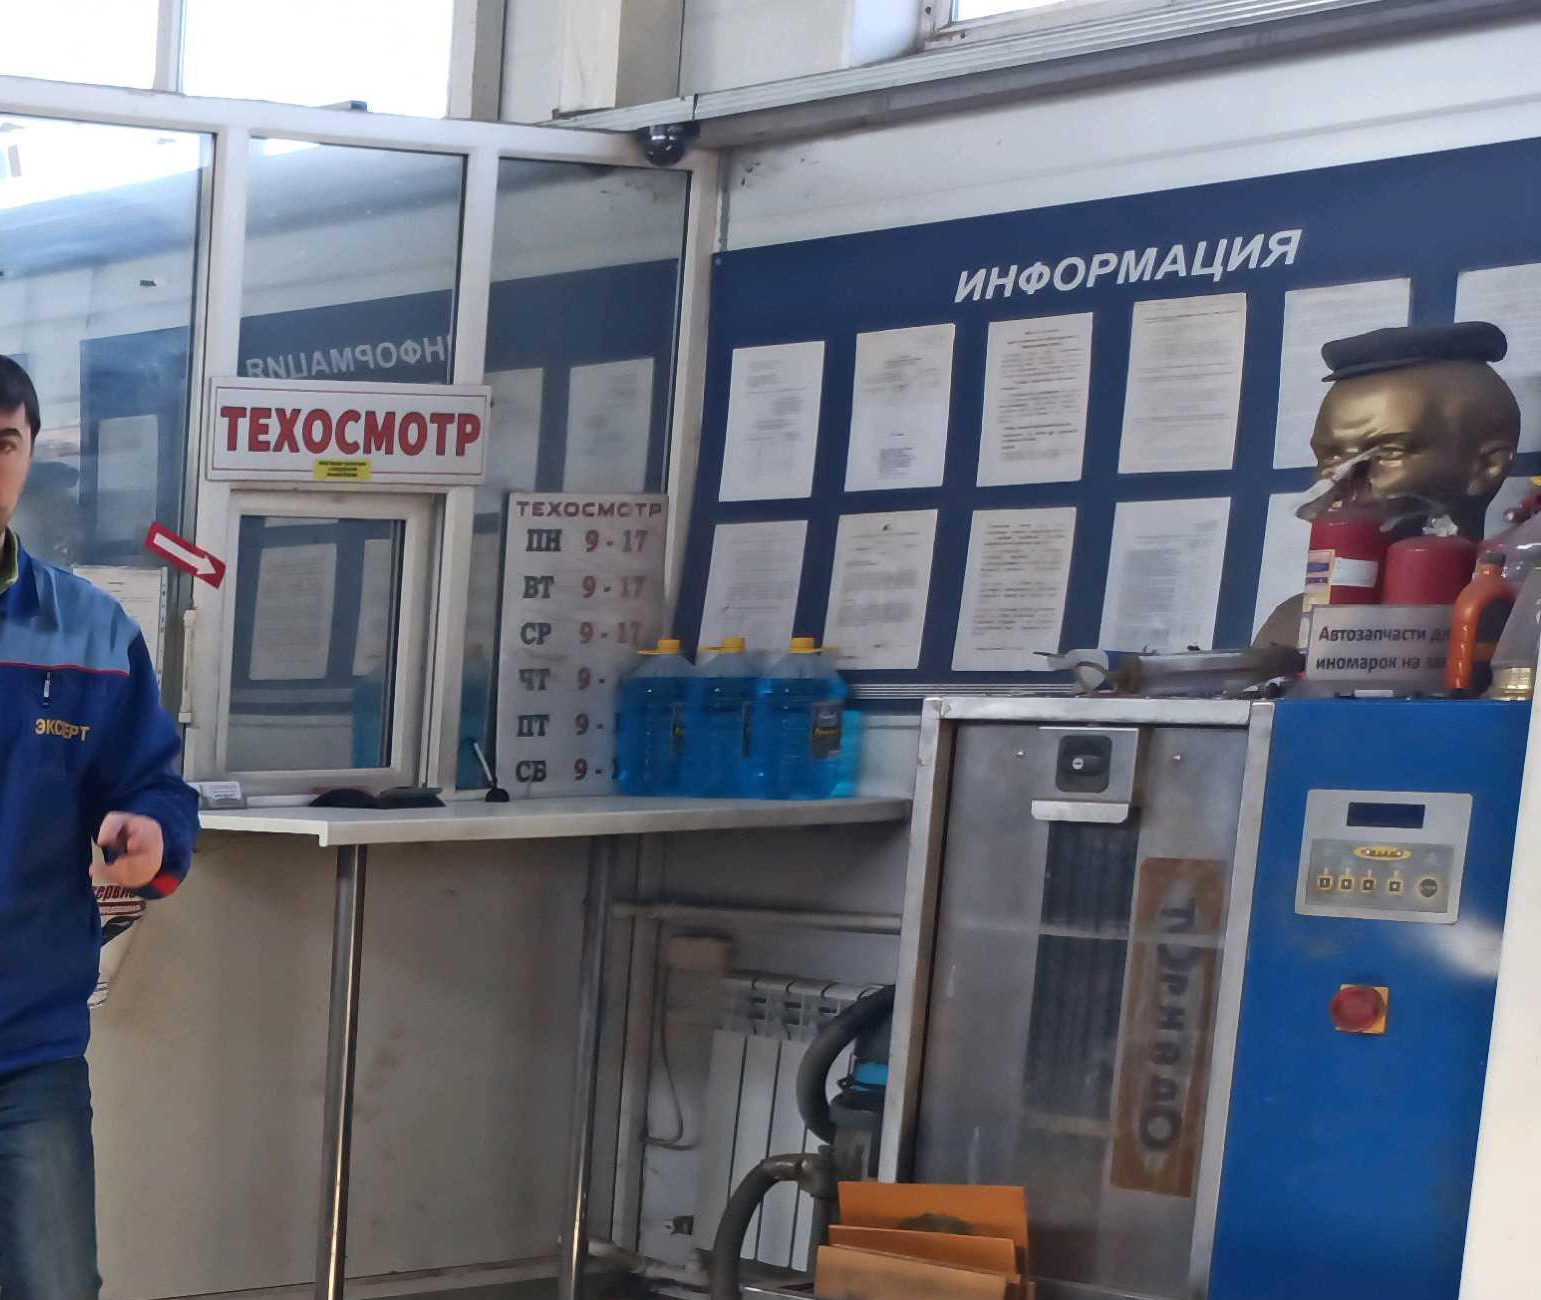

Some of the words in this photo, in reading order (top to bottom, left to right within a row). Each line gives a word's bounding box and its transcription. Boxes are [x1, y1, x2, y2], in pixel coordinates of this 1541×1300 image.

[953, 228, 1303, 303] ИНФОРМАЦИЯ
[220, 406, 481, 457] ТЕХОСМОТР
[517, 501, 662, 517] ТЕХОСМОТР
[526, 529, 562, 552] ПН
[585, 529, 599, 552] 9
[622, 530, 648, 552] 17
[523, 576, 554, 599] ВТ
[582, 576, 596, 599] 9
[621, 576, 646, 598] 17
[520, 622, 551, 645] СР
[579, 622, 594, 644] 9
[1319, 626, 1426, 643] Автозапчасти
[1430, 632, 1450, 644] дл
[1316, 656, 1397, 673] иномарок
[1402, 657, 1420, 669] на
[519, 668, 550, 691] ЧТ
[578, 667, 591, 689] 9
[517, 714, 549, 737] ПТ
[575, 713, 589, 735] 9
[516, 760, 547, 783] СБ
[574, 758, 588, 780] 9
